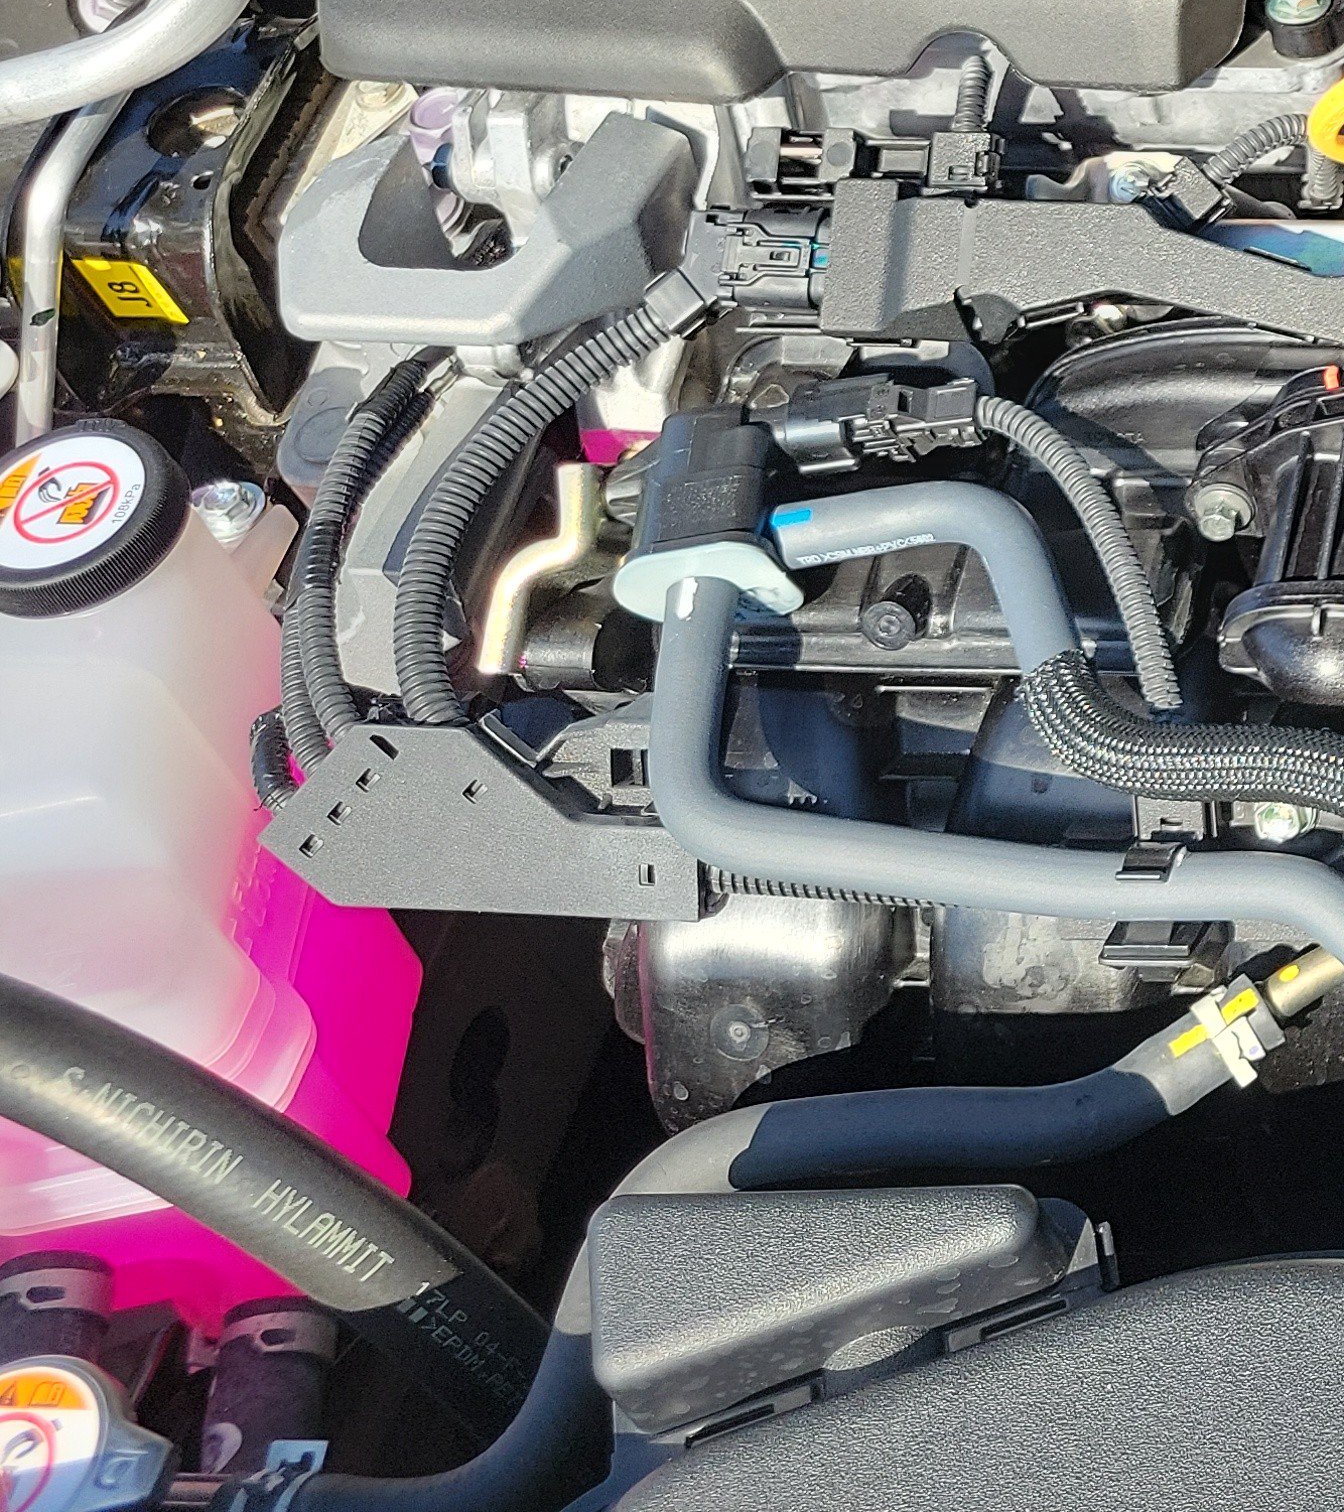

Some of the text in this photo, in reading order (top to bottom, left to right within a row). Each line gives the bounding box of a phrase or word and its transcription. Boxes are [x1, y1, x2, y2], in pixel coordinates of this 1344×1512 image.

[107, 281, 152, 308] J8
[111, 483, 141, 525] 108kPa
[252, 1178, 395, 1284] HYLAMMIT
